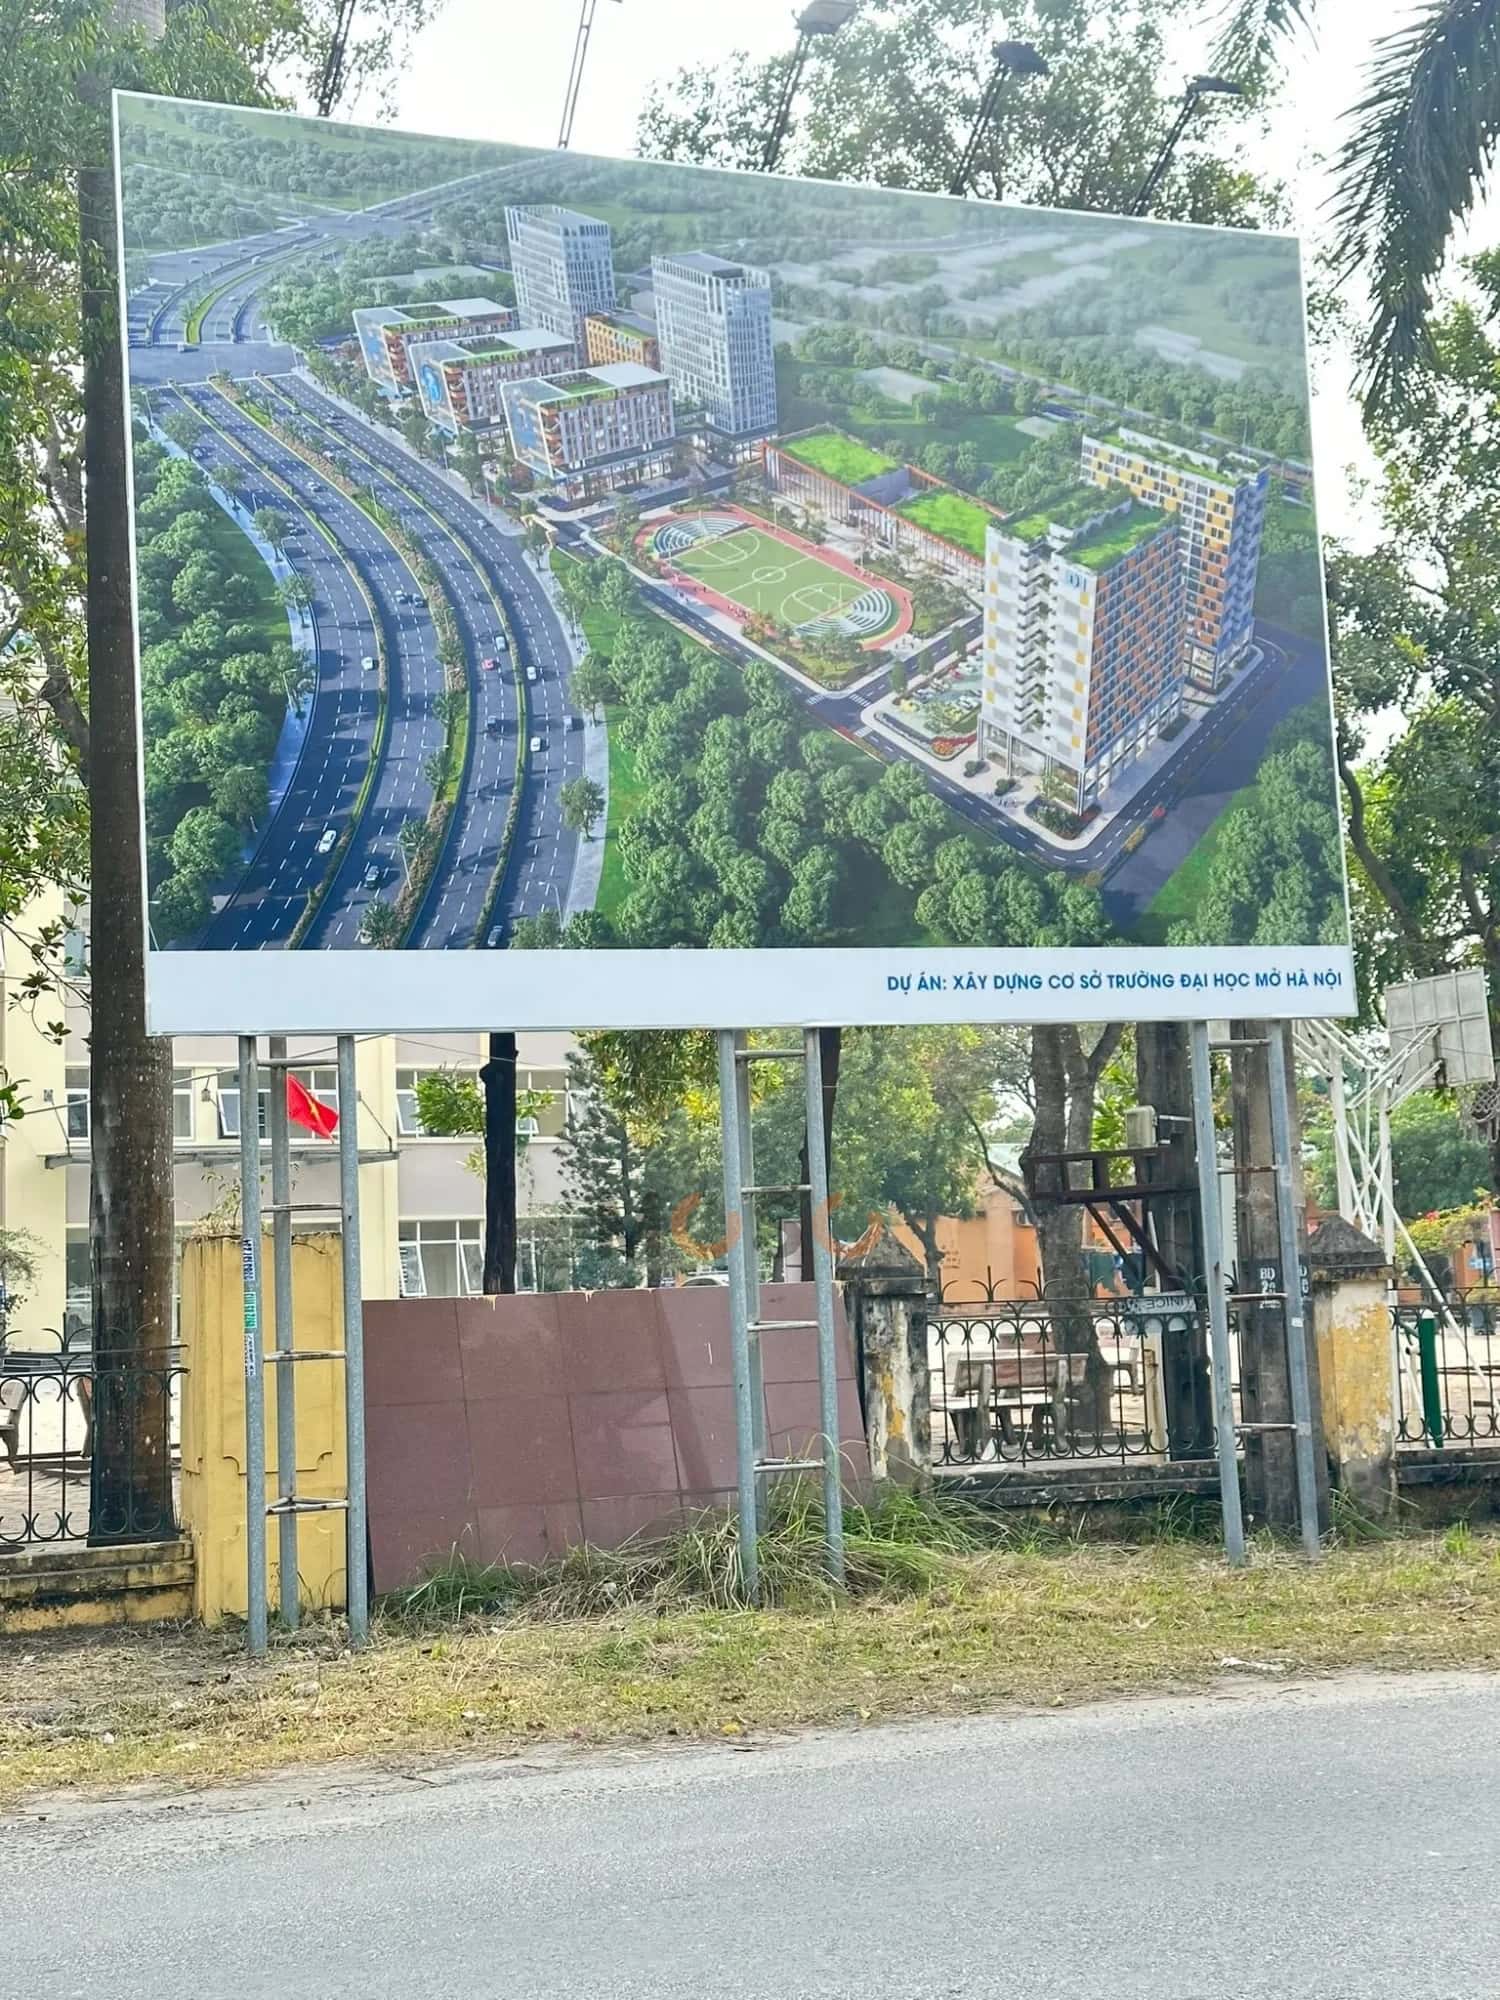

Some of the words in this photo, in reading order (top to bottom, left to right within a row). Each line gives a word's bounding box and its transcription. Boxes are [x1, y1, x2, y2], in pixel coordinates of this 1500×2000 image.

[887, 973, 911, 995] DỰ
[917, 971, 947, 991] ÁN:
[952, 971, 988, 990] XÂY
[993, 973, 1042, 994] DỰNG
[1048, 973, 1075, 990] CƠ
[1080, 969, 1103, 990] SỞ
[1106, 970, 1175, 989] TRƯỜNG
[1180, 973, 1208, 991] ĐẠI
[1213, 972, 1251, 991] HỌC
[1255, 968, 1282, 987] MỞ
[1286, 968, 1308, 987] HÀ
[1314, 968, 1342, 990] NỘI
